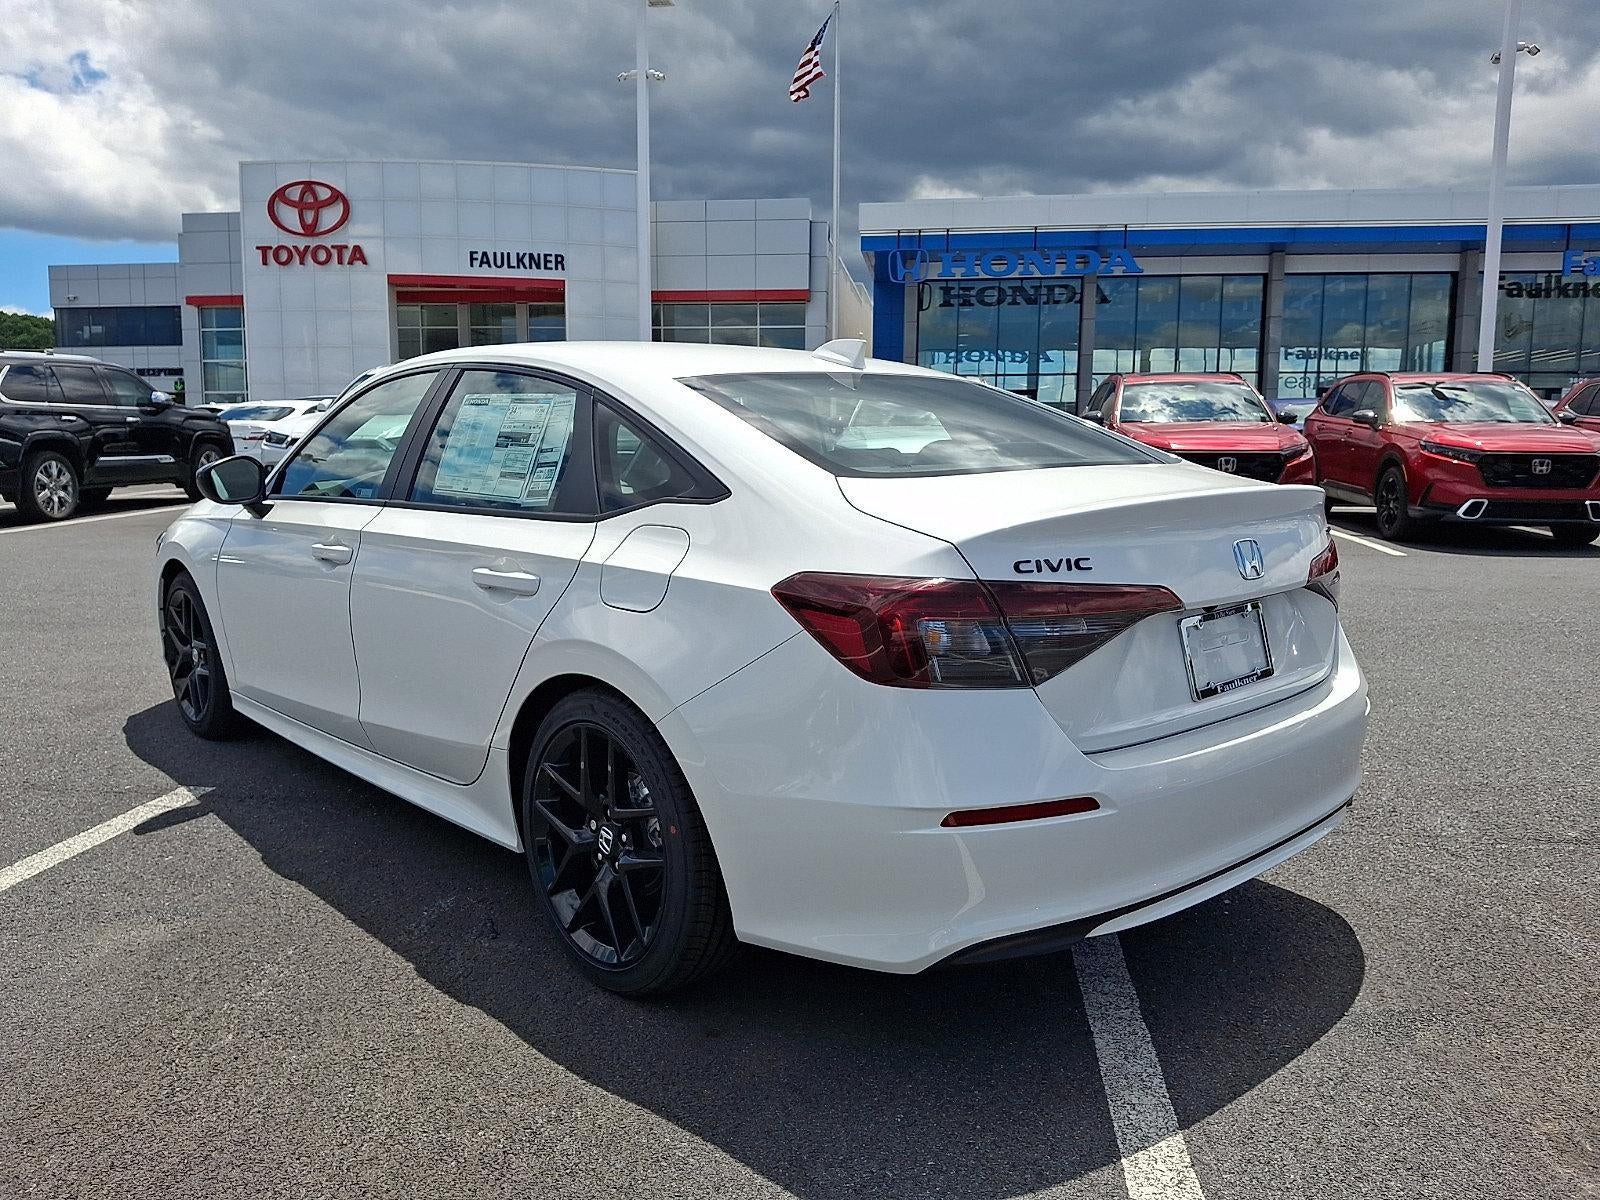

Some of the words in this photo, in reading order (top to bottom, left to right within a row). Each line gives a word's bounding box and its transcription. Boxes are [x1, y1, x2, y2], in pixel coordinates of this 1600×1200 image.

[255, 244, 368, 266] TOYOTA
[469, 250, 566, 271] FAULKNER
[938, 249, 1144, 278] HONDA
[1013, 557, 1093, 574] CIVIC
[1216, 674, 1258, 694] Faulkner
